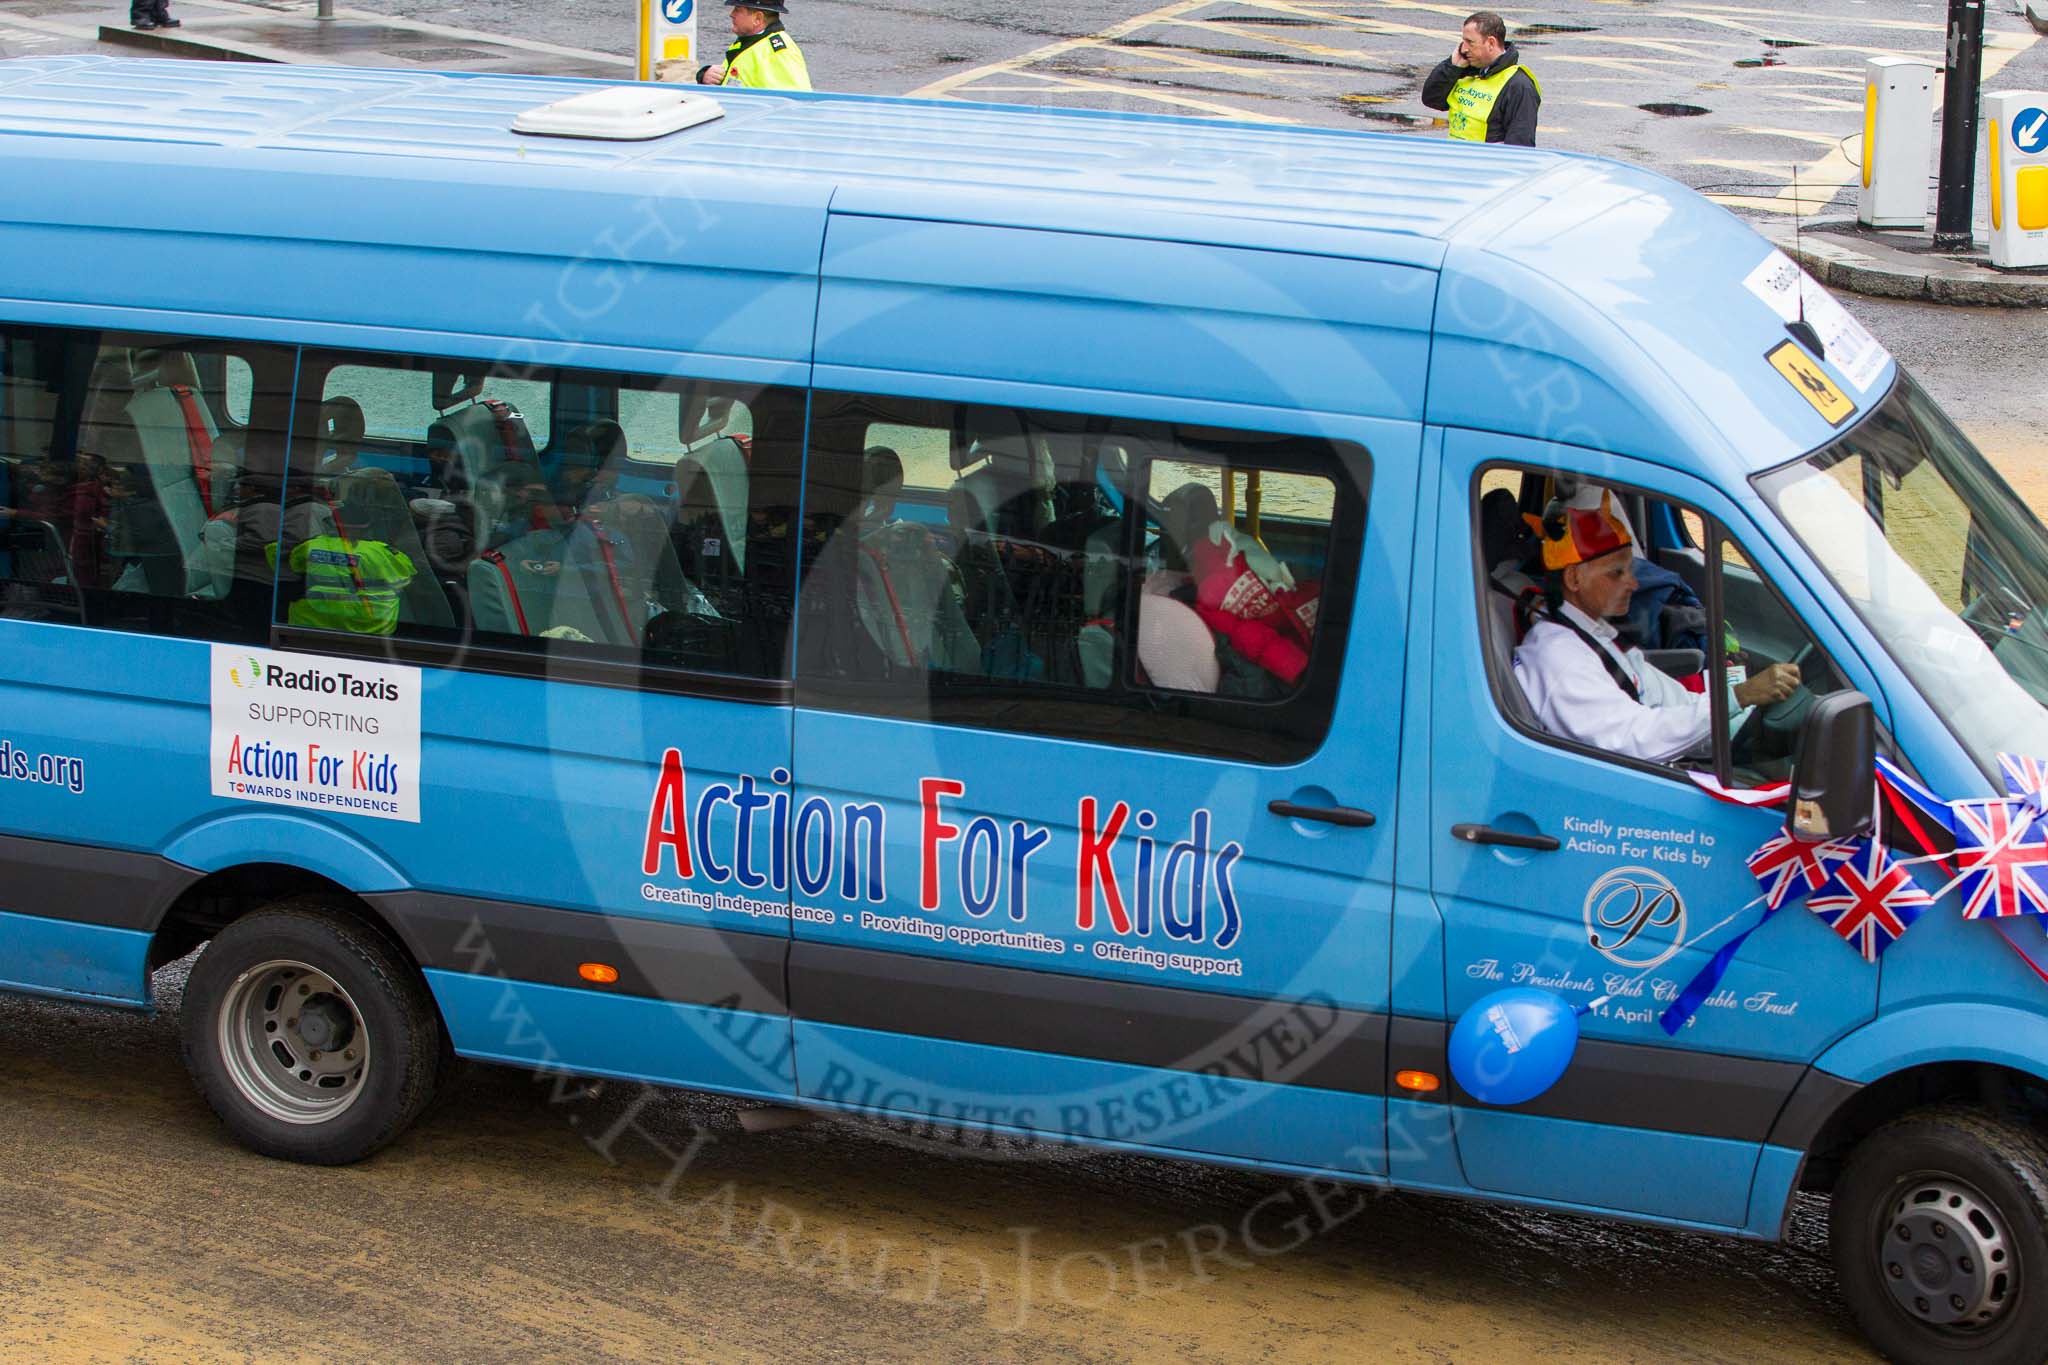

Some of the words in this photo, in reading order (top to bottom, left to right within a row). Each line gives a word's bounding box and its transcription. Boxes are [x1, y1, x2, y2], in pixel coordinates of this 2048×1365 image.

[267, 664, 399, 701] RadioTaxis
[249, 702, 380, 734] SUPPORTING
[228, 734, 298, 782] Action
[308, 743, 344, 787] For
[352, 749, 398, 795] Kids
[296, 790, 399, 813] INDEPENDENCE
[642, 747, 886, 903] Action
[920, 777, 1049, 921] For
[1076, 796, 1243, 948] Kids
[1563, 816, 1612, 838] Kindly
[1617, 826, 1695, 844] presented
[1700, 833, 1715, 846] to
[1566, 837, 1616, 855] Action
[1621, 843, 1648, 859] For
[1652, 846, 1687, 863] Kids
[1692, 850, 1712, 868] by
[641, 883, 712, 910] Creating
[716, 892, 834, 923] independence
[861, 912, 943, 941] Providing
[949, 924, 1064, 953] opportunities
[1094, 942, 1167, 968] Offering
[1170, 955, 1242, 977] support
[1466, 959, 1504, 981] The
[1603, 972, 1645, 997] Club
[1743, 991, 1798, 1015] Trust
[1614, 1006, 1653, 1023] April
